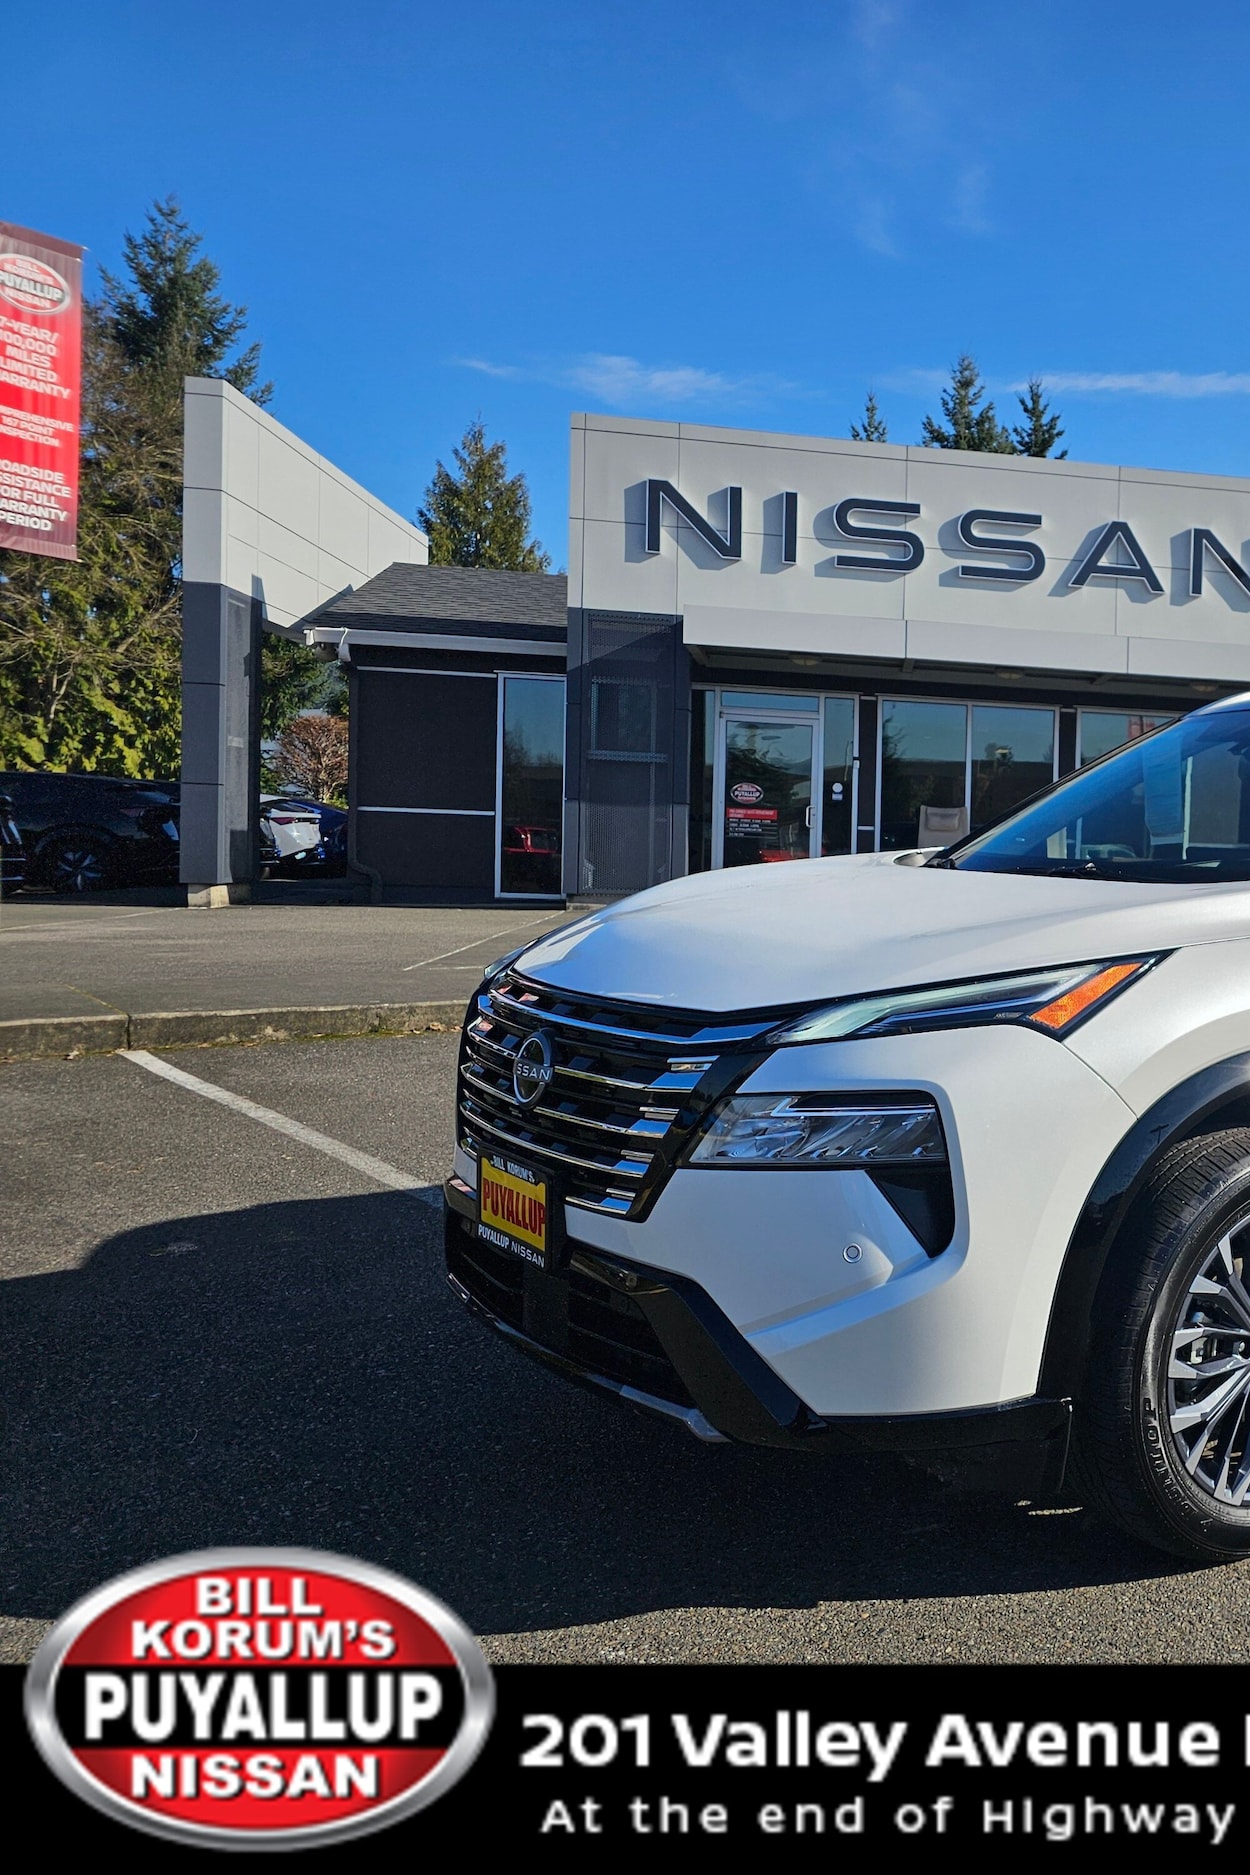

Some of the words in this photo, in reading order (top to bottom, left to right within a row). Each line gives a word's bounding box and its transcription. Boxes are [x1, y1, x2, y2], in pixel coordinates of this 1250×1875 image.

[0, 270, 63, 301] PUYALLUP
[6, 345, 51, 368] MILES
[0, 356, 57, 382] LIMITED
[0, 369, 71, 399] ARRANTY
[20, 421, 55, 437] POINT
[0, 459, 65, 484] OADSIDE
[0, 485, 22, 500] OR
[23, 490, 60, 509] FULL
[0, 498, 68, 522] ARRANTY
[0, 511, 53, 531] PERIOD
[516, 1063, 551, 1081] SSAN
[482, 1178, 546, 1237] PUYALLUP
[478, 1224, 510, 1249] PUYALLUP
[511, 1241, 545, 1268] NISSAN
